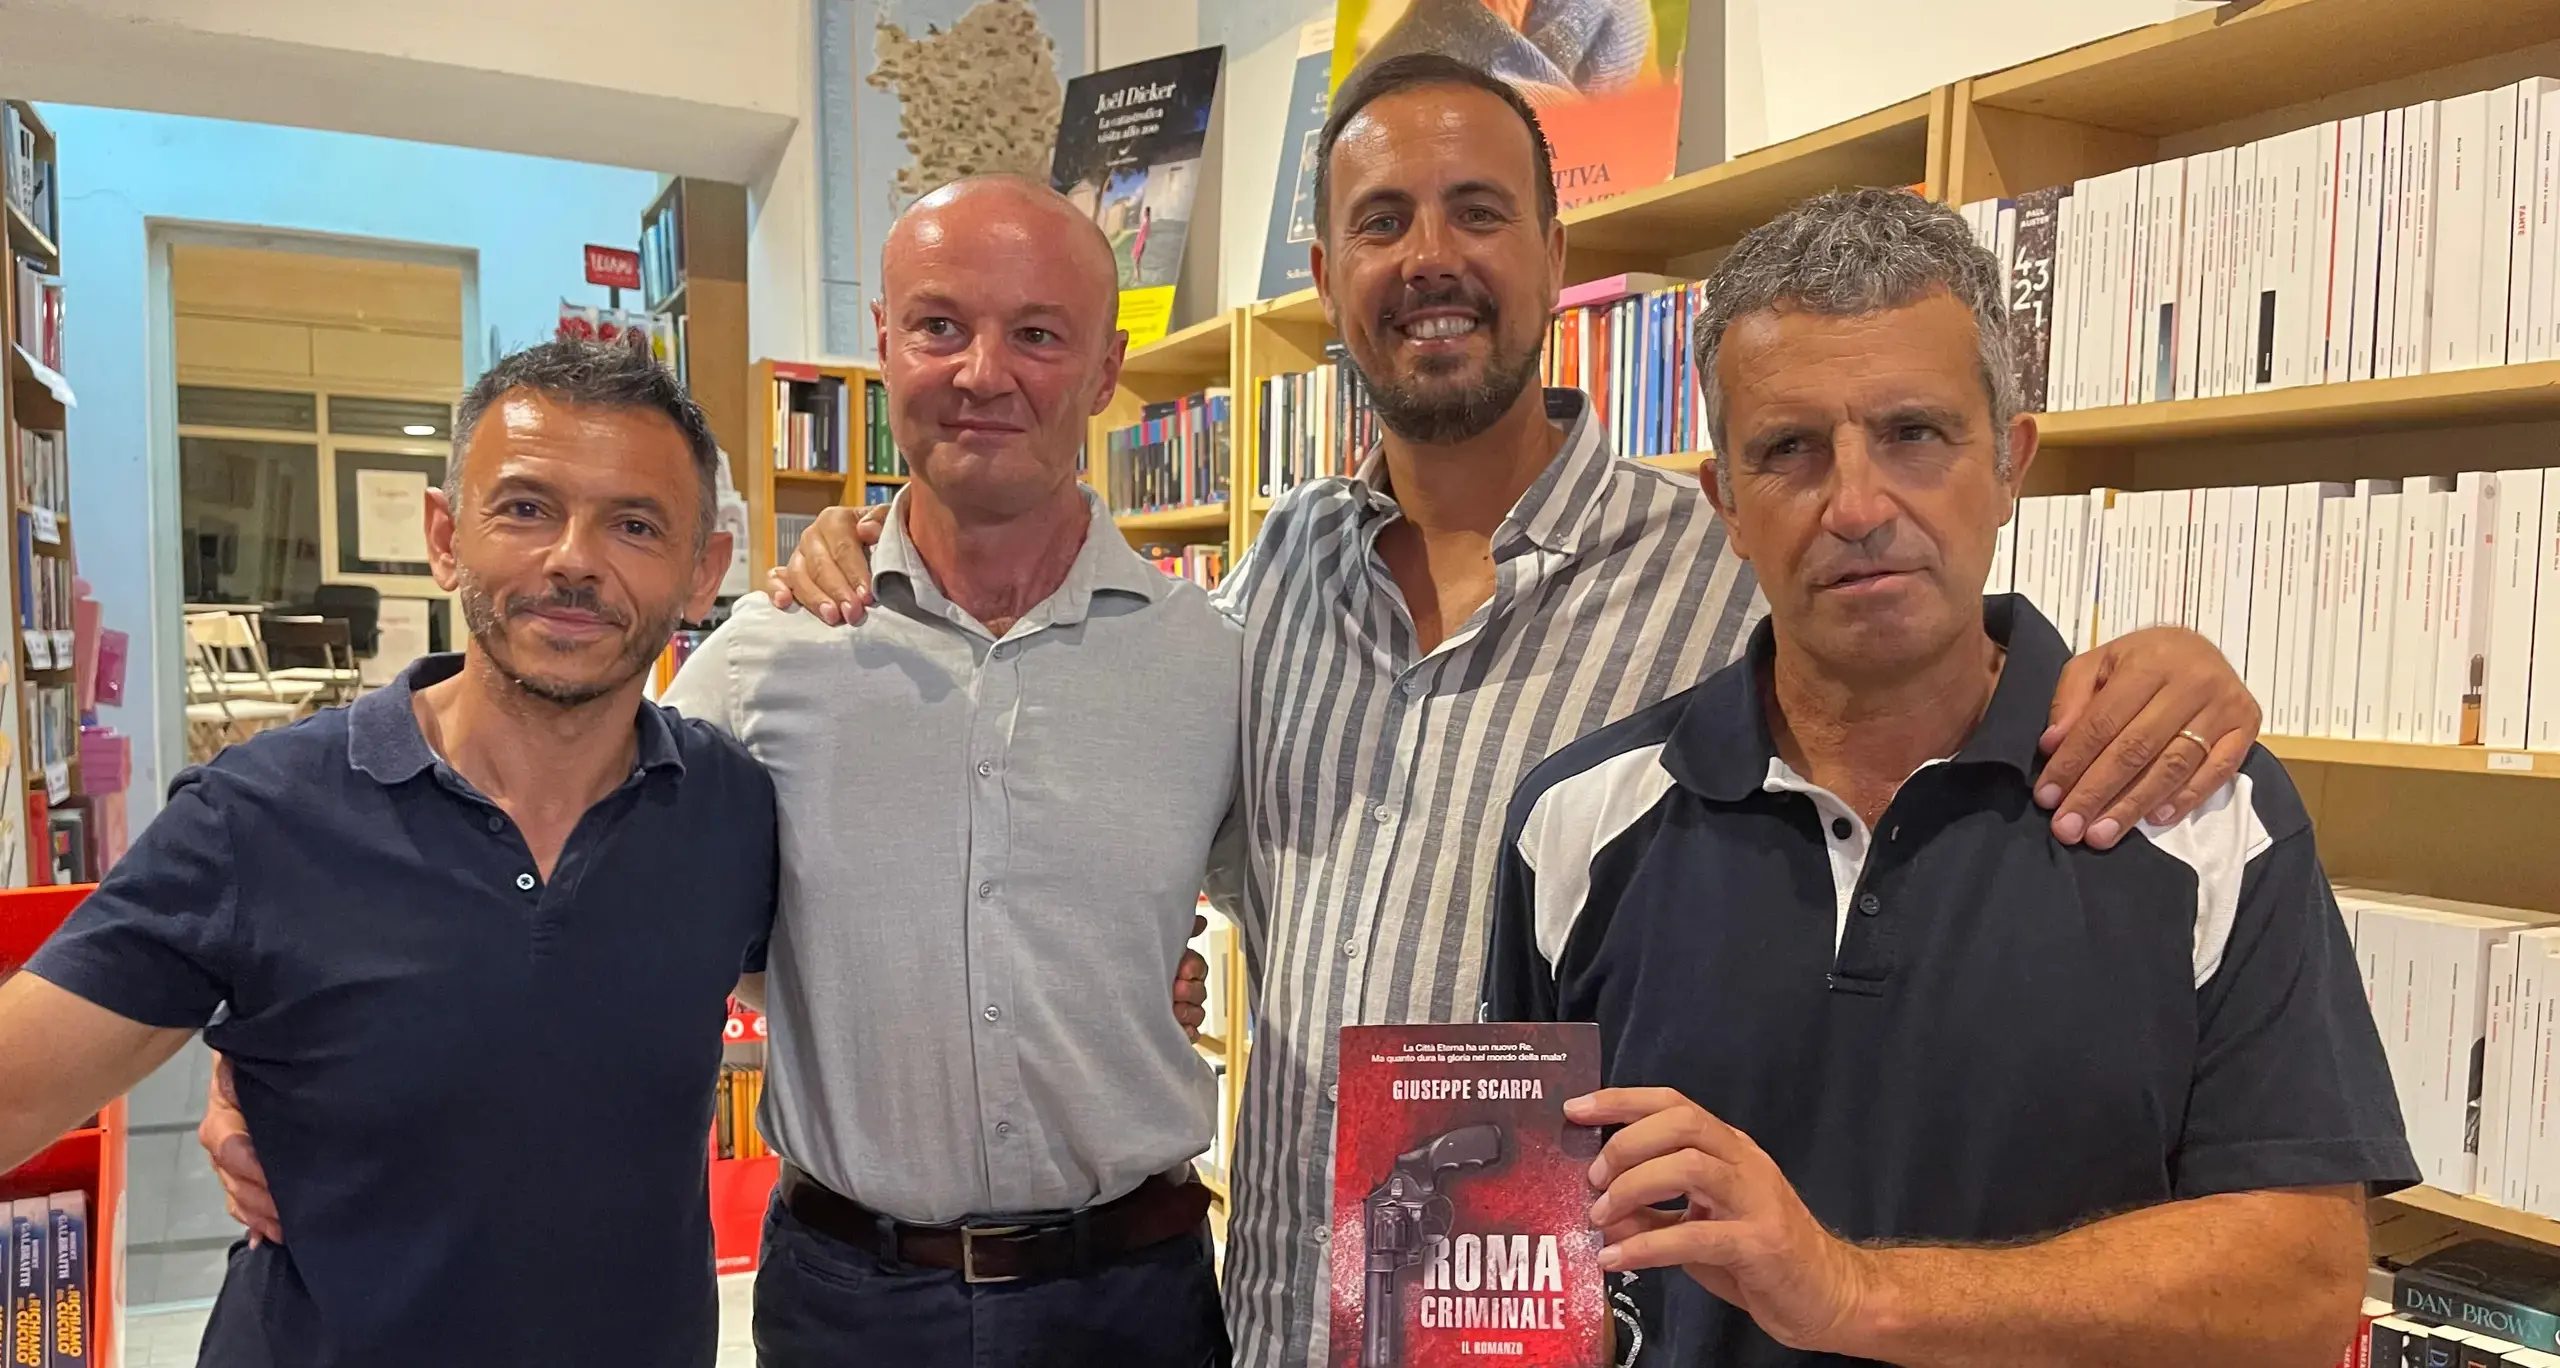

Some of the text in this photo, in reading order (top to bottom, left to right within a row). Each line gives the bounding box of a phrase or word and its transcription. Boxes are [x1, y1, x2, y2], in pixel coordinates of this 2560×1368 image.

[1126, 81, 1177, 106] Dicker
[2020, 215, 2050, 229] AUSTER
[2025, 207, 2045, 219] PAUL
[2518, 205, 2527, 236] FANTE
[1371, 1052, 1568, 1064] Ma quanto dura la gloria nel mondo della mala?
[1402, 1043, 1414, 1052] La
[1415, 1043, 1436, 1052] Città
[1437, 1043, 1464, 1052] Eterna
[1465, 1043, 1477, 1052] ha
[1478, 1044, 1489, 1052] un
[1519, 1042, 1534, 1051] Re.
[1392, 1078, 1544, 1100] GIUSEPPE SCARPA
[20, 1222, 31, 1288] GALBRAITH
[58, 1214, 70, 1279] GALBRAITH
[1423, 1233, 1563, 1291] ROMA
[57, 1302, 70, 1354] CUCULO
[68, 1290, 82, 1357] RICHIAMO
[1420, 1295, 1565, 1330] CRIMINALE
[2406, 1287, 2542, 1338] DAN BROWN
[16, 1310, 29, 1363] CUCULO
[28, 1299, 41, 1367] RICHIAMO
[1461, 1340, 1524, 1355] IL ROMANZO
